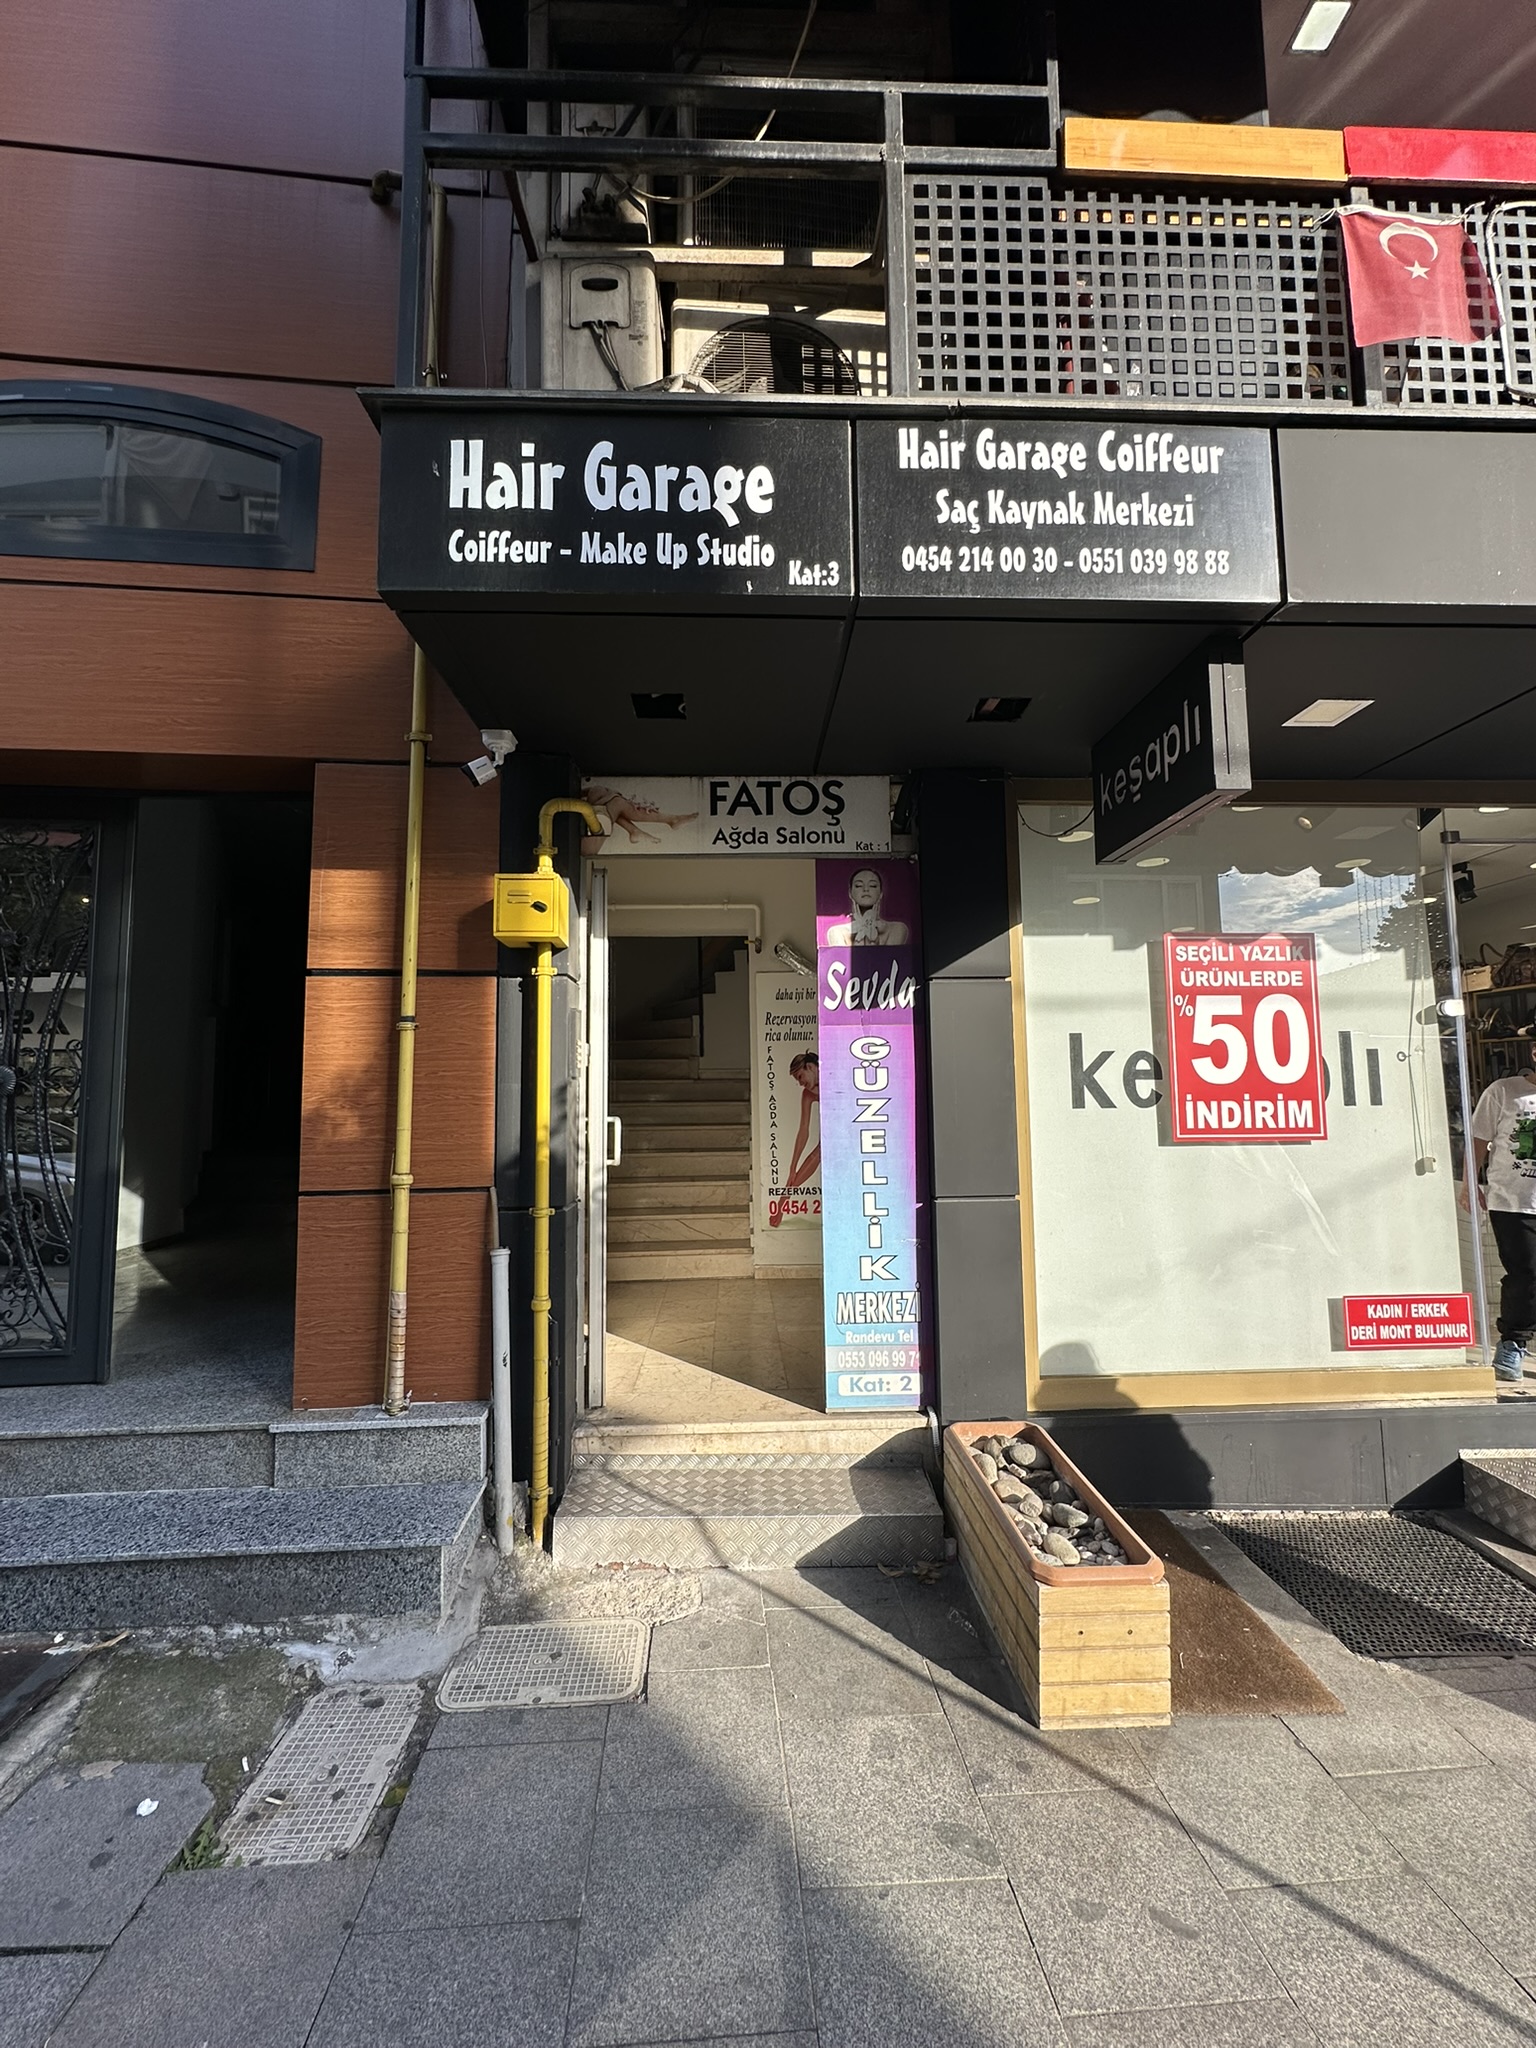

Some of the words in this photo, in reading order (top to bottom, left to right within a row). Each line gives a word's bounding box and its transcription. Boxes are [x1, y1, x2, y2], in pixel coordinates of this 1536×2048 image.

[898, 427, 966, 470] Hair
[976, 428, 1087, 478] Garage
[1098, 430, 1225, 474] Coiffeur
[449, 439, 565, 511] Hair
[583, 440, 775, 527] Garage
[936, 488, 980, 534] Saç
[987, 489, 1086, 530] Kaynak
[1093, 491, 1195, 527] Merkezi
[448, 529, 552, 564] Coiffeur
[580, 531, 648, 565] Make
[656, 532, 689, 569] Up
[696, 532, 775, 567] Studio
[902, 545, 953, 573] 0454
[958, 546, 994, 573] 214
[1000, 546, 1026, 573] 00
[1032, 546, 1058, 574] 30
[1079, 547, 1124, 575] 0551
[1130, 548, 1168, 575] 039
[1173, 549, 1199, 576] 98
[1204, 549, 1230, 576] 88
[788, 559, 840, 587] Kat:3
[1100, 699, 1201, 817] keşaplı
[709, 780, 845, 826] FATOŞ
[712, 826, 769, 849] Ağda
[776, 826, 845, 845] Salonu
[855, 841, 874, 851] Kat
[1175, 942, 1235, 965] SEÇİLİ
[1239, 944, 1306, 962] YAZLIK
[822, 959, 921, 1012] Sevda
[1180, 967, 1304, 987] ÜRÜNLERDE
[775, 988, 793, 1000] daha
[795, 987, 804, 1004] iyi
[805, 987, 816, 1000] bir
[765, 1011, 817, 1028] Rezervasyon
[765, 1028, 781, 1042] rica
[783, 1027, 814, 1042] olunur.
[766, 1046, 776, 1091] FATOŞ
[1185, 1093, 1315, 1130] İNDİRİM
[769, 1133, 779, 1185] SALONU
[849, 1035, 899, 1281] GÜZELLİK
[781, 1200, 809, 1215] 454
[836, 1282, 922, 1325] MERKEZİ
[1367, 1303, 1403, 1318] KADIN
[1411, 1303, 1449, 1318] ERKEK
[845, 1329, 895, 1344] Randevu
[897, 1328, 914, 1342] Tel
[1351, 1322, 1377, 1340] DERİ
[1380, 1325, 1412, 1340] MONT
[1415, 1323, 1469, 1339] BULUNUR
[838, 1350, 866, 1368] 0553
[868, 1350, 889, 1367] 096
[892, 1350, 906, 1367] 99
[850, 1376, 891, 1393] Kat:
[900, 1376, 912, 1392] 2
